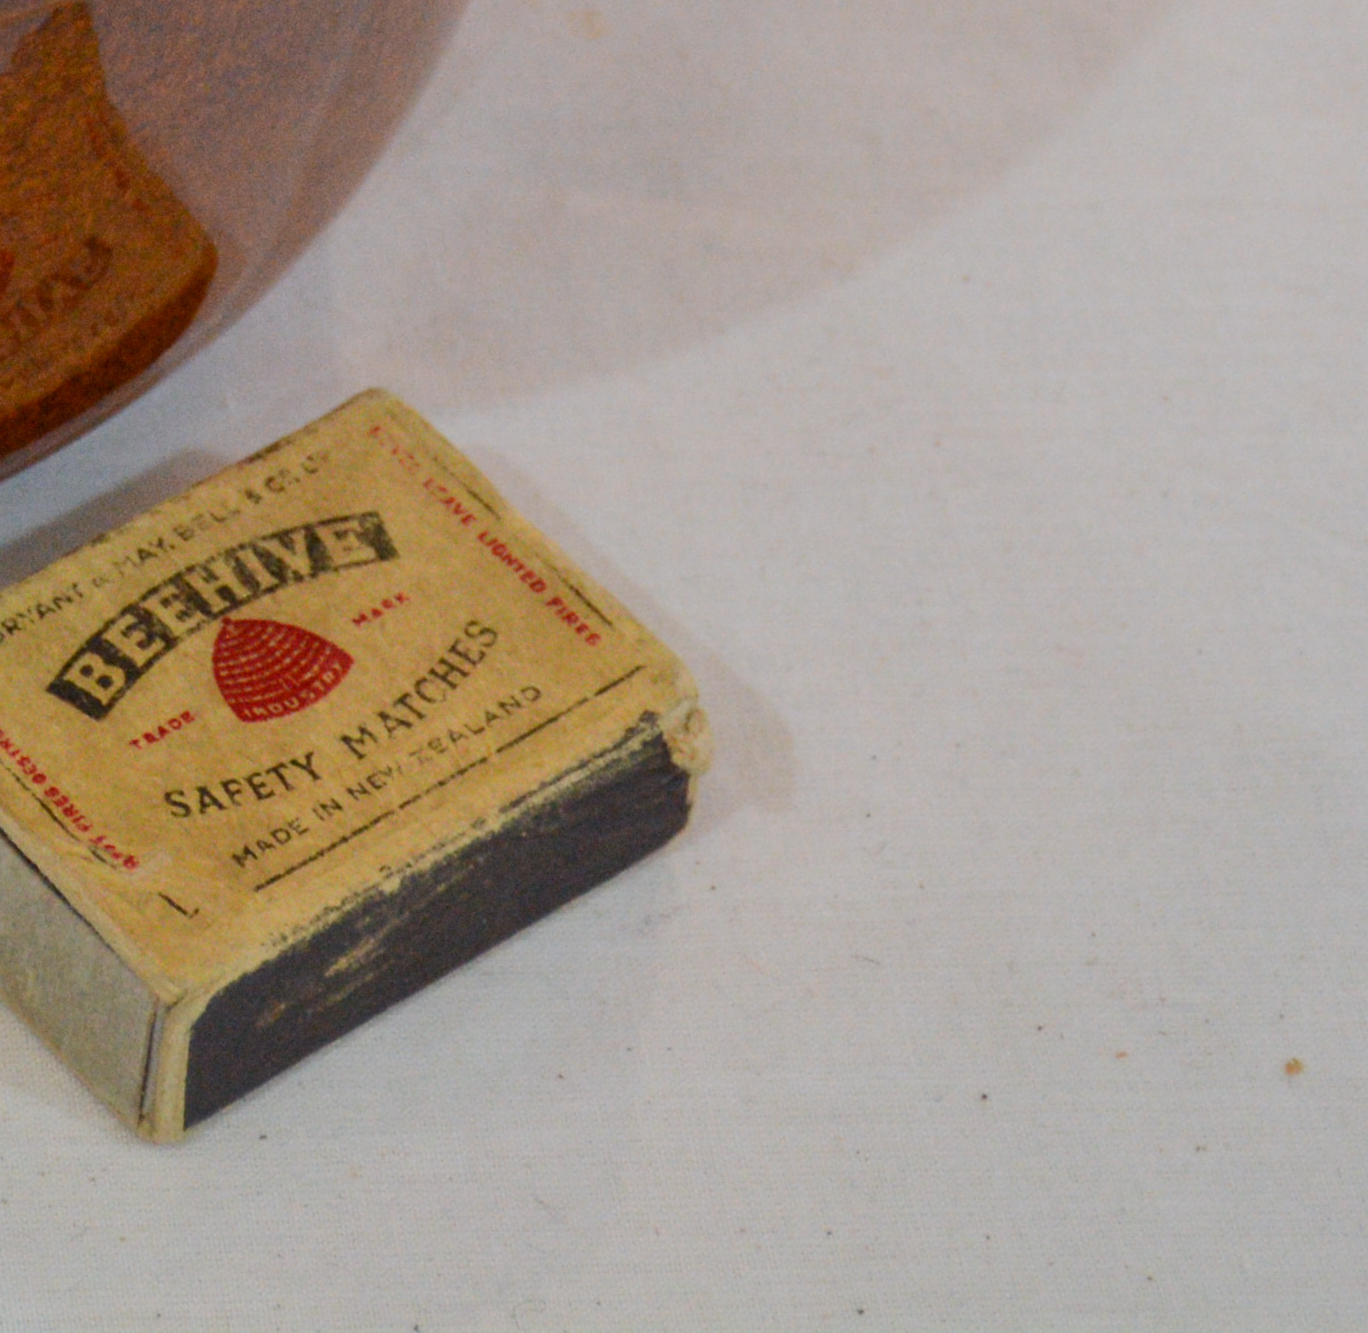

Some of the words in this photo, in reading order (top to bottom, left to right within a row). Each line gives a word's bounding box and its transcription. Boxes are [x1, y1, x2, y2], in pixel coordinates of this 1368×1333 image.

[61, 517, 382, 711] BEEHIVE
[128, 709, 196, 750] TRADE
[164, 751, 323, 821] SAFETY
[339, 619, 500, 761] MATCHES
[230, 816, 310, 869] MADE
[311, 797, 344, 821] IN
[345, 763, 405, 801] NEW
[408, 684, 543, 767] ZEALAND
